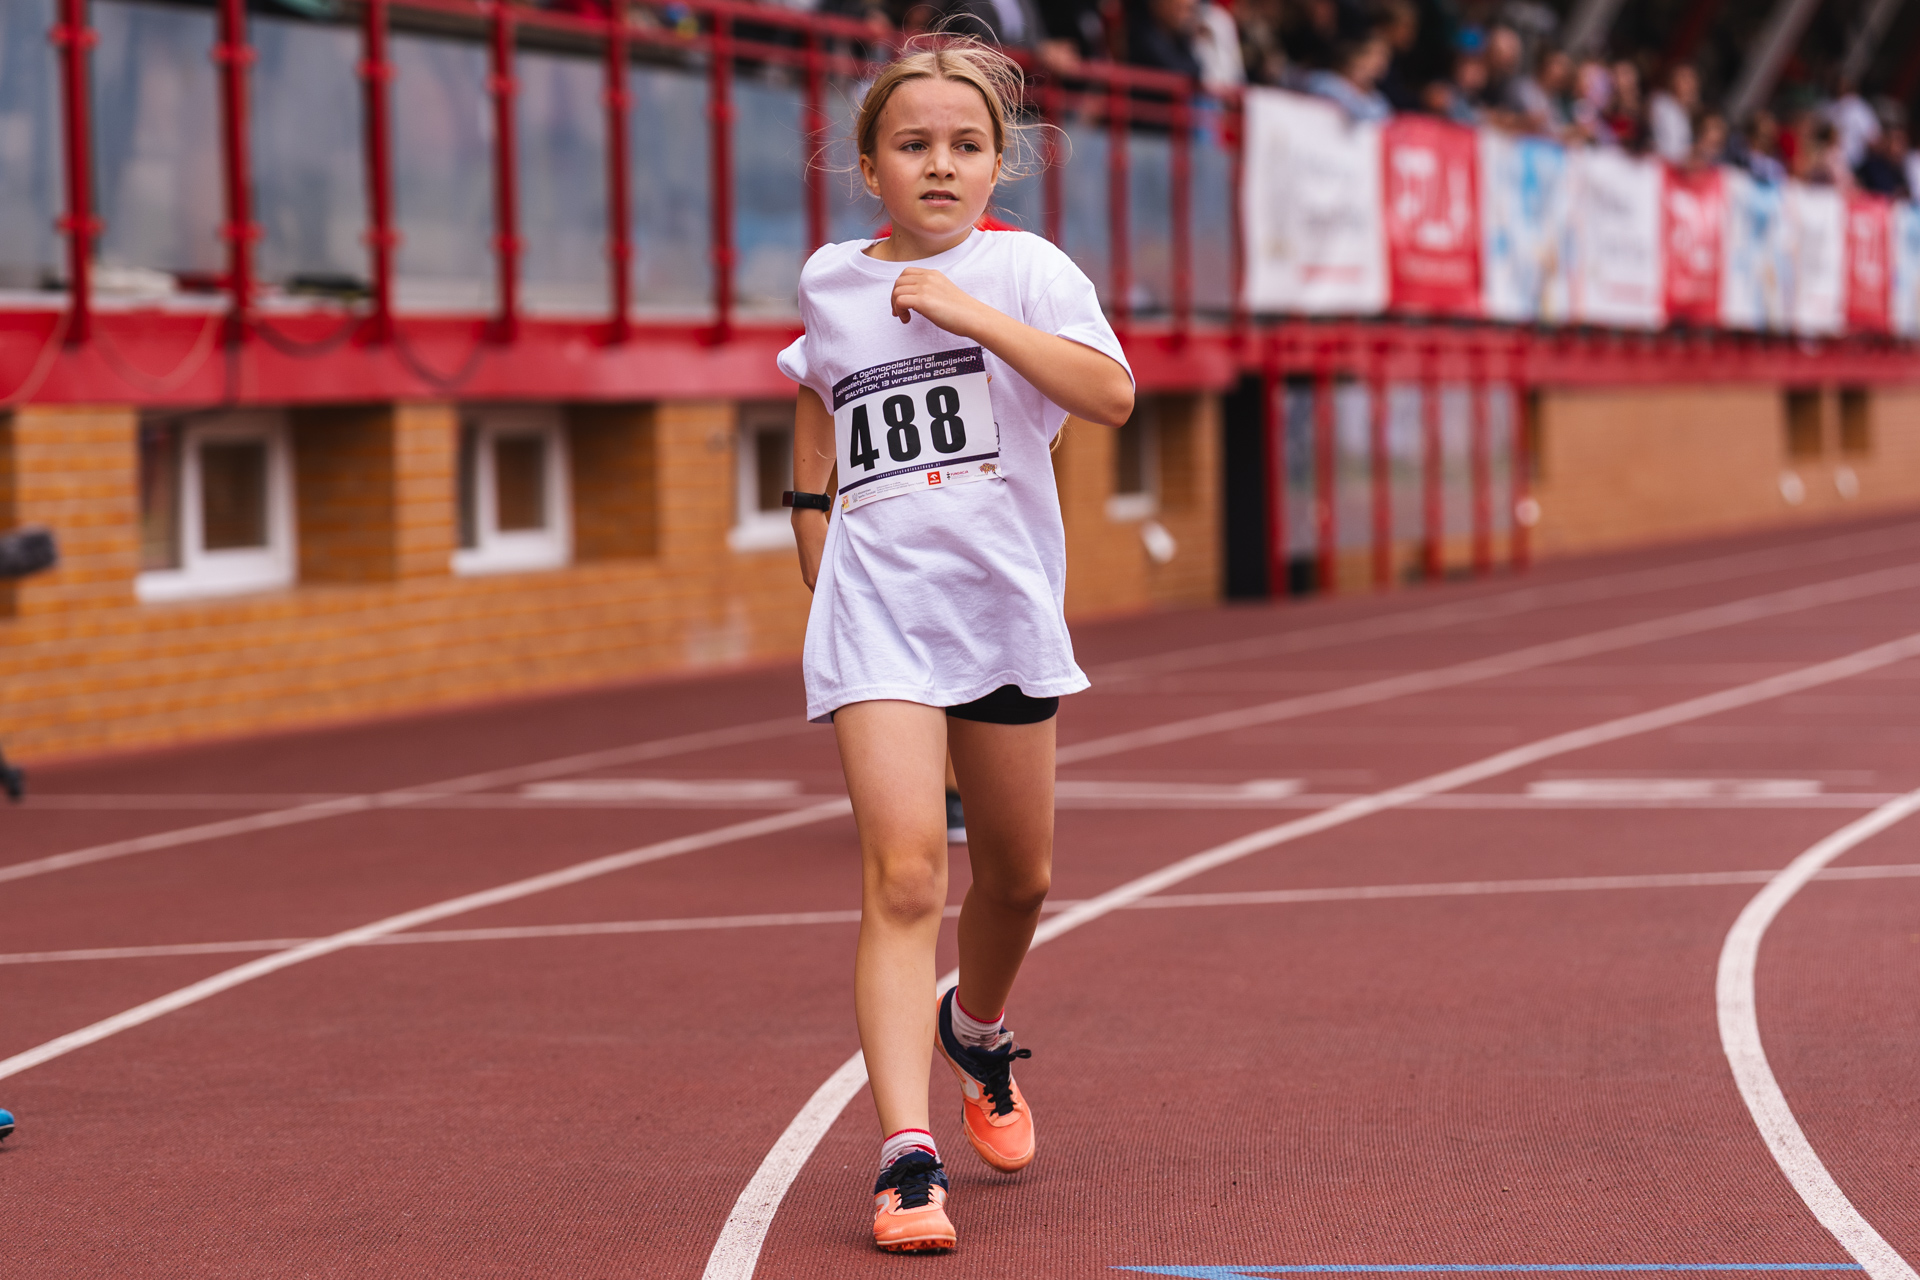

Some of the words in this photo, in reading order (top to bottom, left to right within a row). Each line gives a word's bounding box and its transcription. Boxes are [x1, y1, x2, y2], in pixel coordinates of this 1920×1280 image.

[859, 359, 911, 379] Ogólnopolski
[891, 364, 923, 376] Nadziei
[924, 354, 977, 370] Olimpijskich
[881, 380, 890, 388] 13
[891, 371, 932, 385] września
[933, 366, 957, 378] 2025
[850, 385, 967, 472] 488
